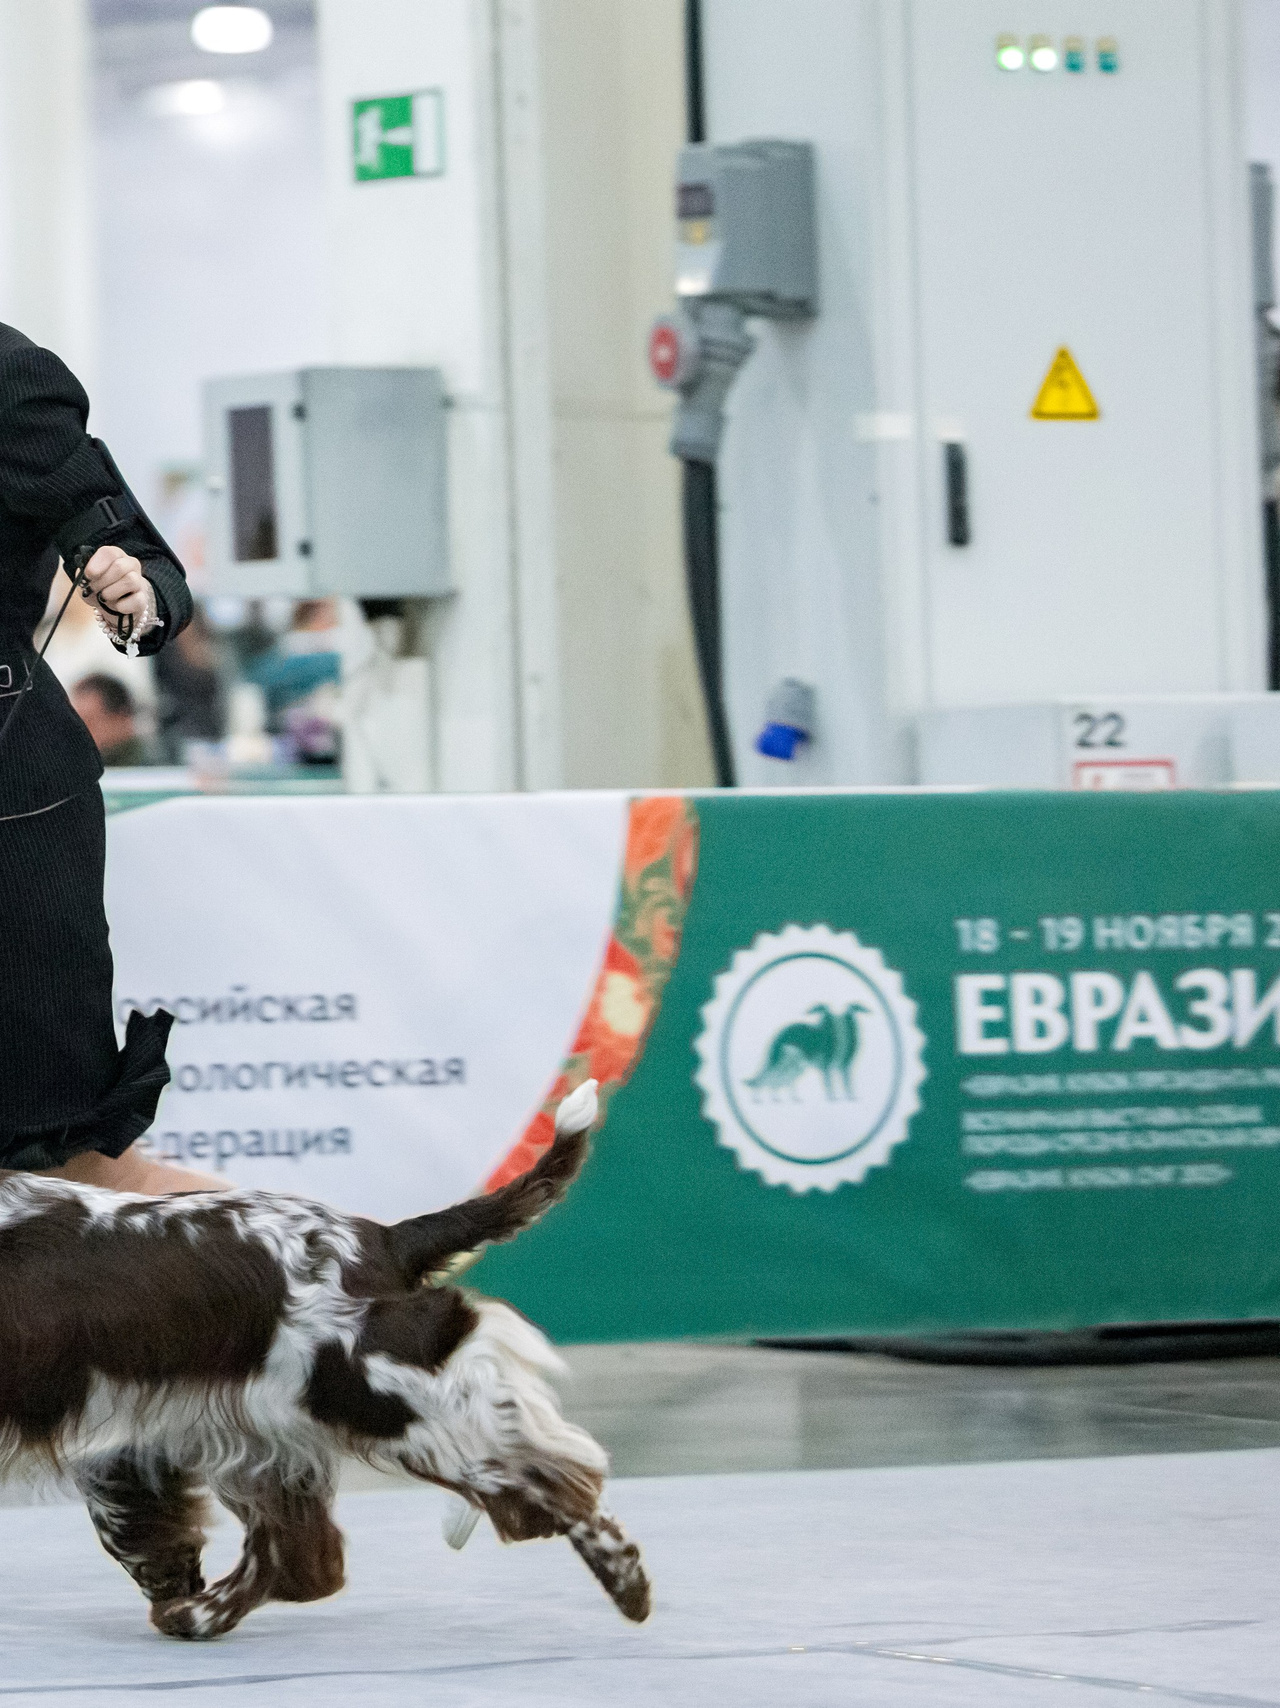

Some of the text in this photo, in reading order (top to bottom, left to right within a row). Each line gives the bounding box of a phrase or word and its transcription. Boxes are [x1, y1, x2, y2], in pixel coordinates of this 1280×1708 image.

[1074, 711, 1126, 748] 22
[954, 917, 999, 953] 18
[1038, 915, 1085, 951] 19
[1092, 912, 1256, 950] НОЯБРЯ
[118, 983, 358, 1024] оссийская
[954, 966, 1280, 1056] ЕВРАЗИ
[170, 1056, 466, 1093] ологическая
[133, 1126, 352, 1172] едерация
